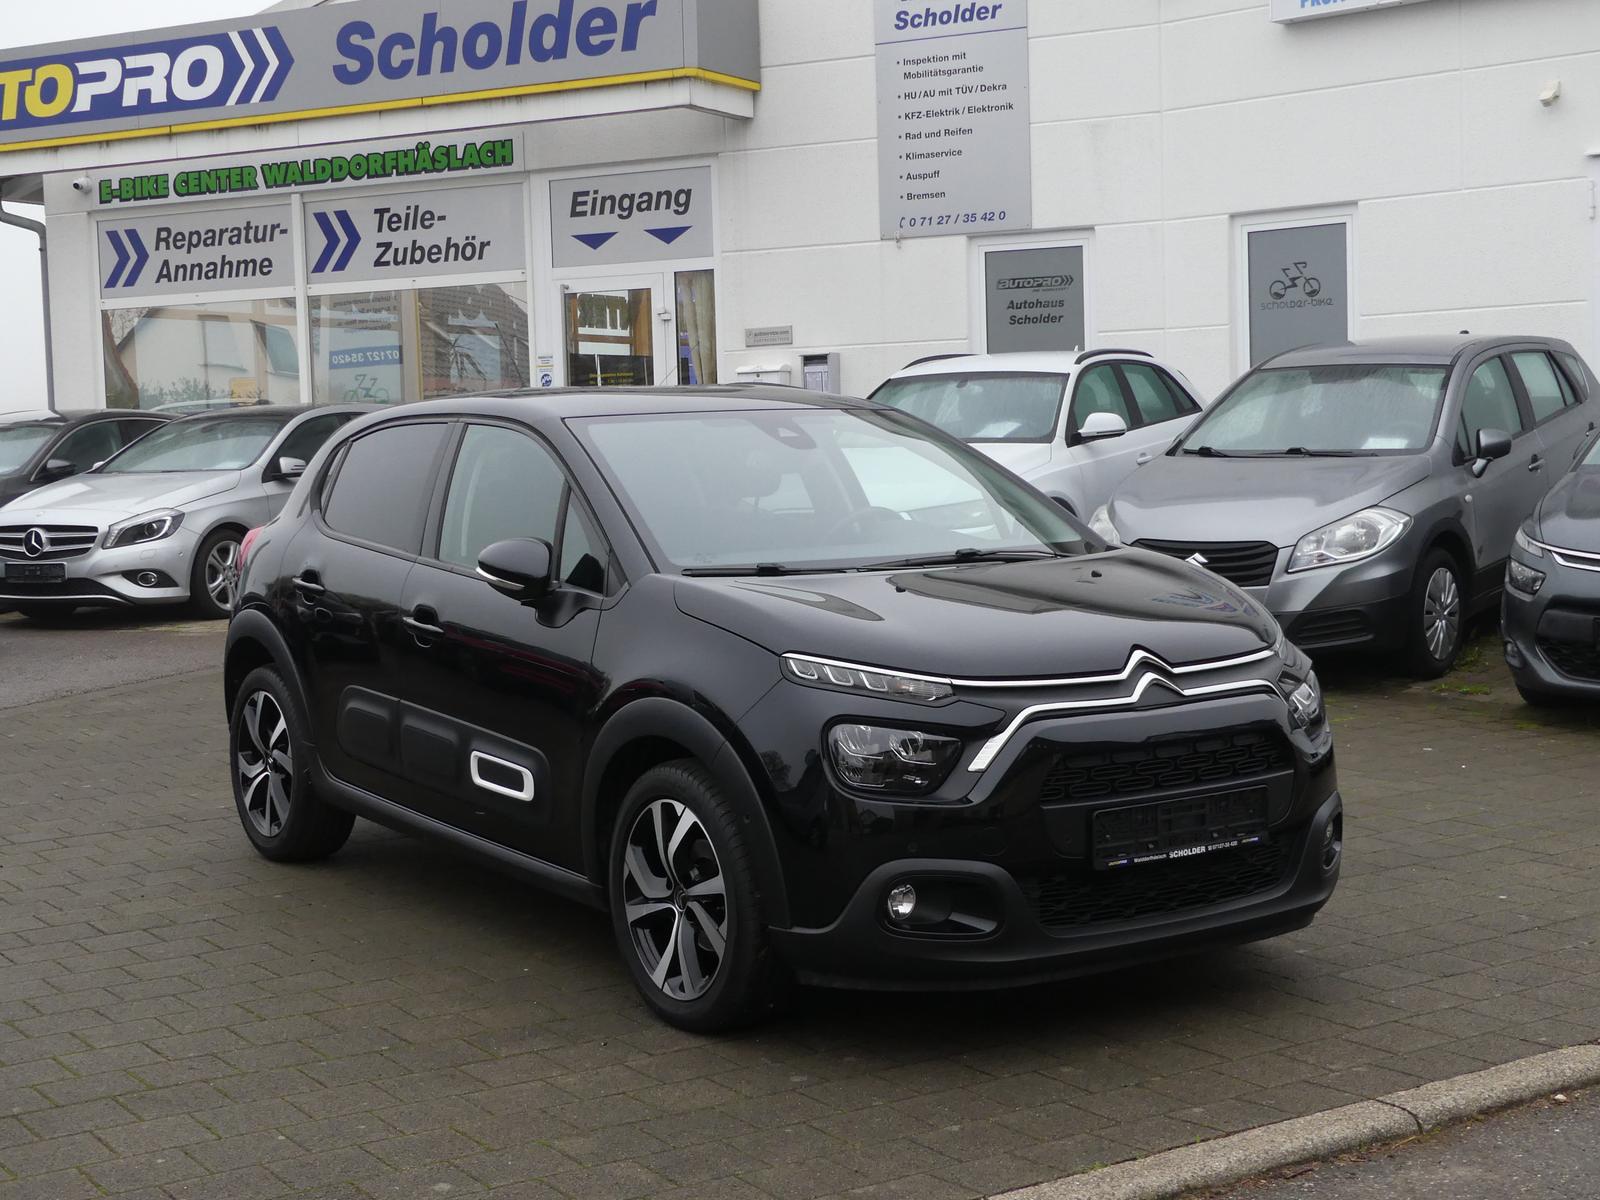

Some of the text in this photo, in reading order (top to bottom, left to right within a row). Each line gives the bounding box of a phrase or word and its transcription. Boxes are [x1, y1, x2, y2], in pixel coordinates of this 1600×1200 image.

[894, 2, 1002, 31] Scholder
[332, 0, 657, 86] Scholder
[903, 52, 966, 67] Inspektion mit
[903, 65, 984, 80] Mobilitätsgarantie
[938, 88, 953, 97] mit
[904, 107, 960, 121] KFZ-Elektrik
[968, 102, 1014, 114] Elektronik
[905, 127, 973, 141] Rad und Reifen
[905, 148, 963, 161] Klimaservice
[99, 139, 514, 203] E-BIKE CENTER WALDDORFHÄSLACH
[906, 170, 940, 181] Auspuff
[570, 187, 692, 220] Eingang
[906, 191, 946, 201] Bremsen
[374, 207, 447, 234] Teile-
[920, 216, 933, 226] 71
[937, 215, 951, 225] 27
[963, 213, 977, 223] 35
[981, 211, 995, 222] 42
[155, 222, 289, 254] Reparatur-
[373, 236, 491, 268] Zubehör
[155, 254, 274, 284] Annahme
[1007, 298, 1065, 311] Autohaus
[1009, 313, 1064, 326] Scholder
[1168, 845, 1206, 859] SCHOLDER
